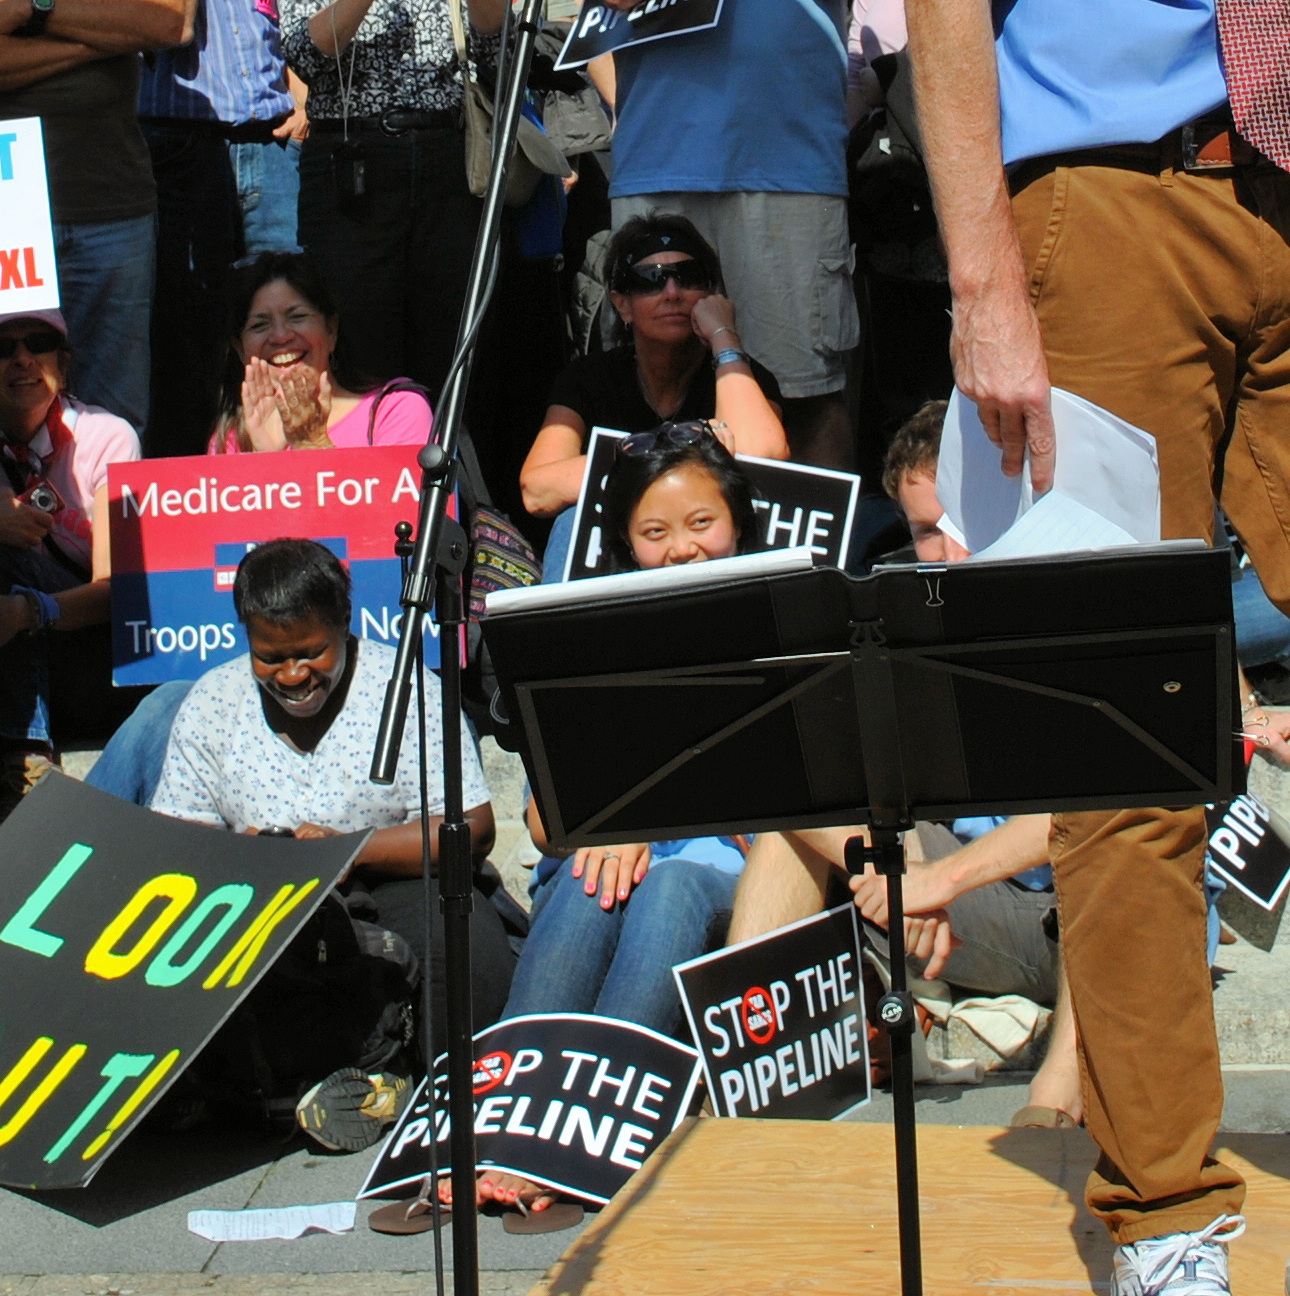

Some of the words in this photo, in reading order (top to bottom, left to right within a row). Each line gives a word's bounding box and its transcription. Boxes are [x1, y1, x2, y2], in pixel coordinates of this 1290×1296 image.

[121, 477, 302, 518] Medicare
[317, 470, 380, 506] For
[392, 468, 421, 502] A
[124, 619, 236, 660] Troops
[704, 980, 791, 1057] STOP
[795, 952, 855, 1018] THE
[415, 1049, 542, 1114] SOP
[562, 1050, 681, 1120] THE
[720, 1014, 860, 1118] PIPELINE
